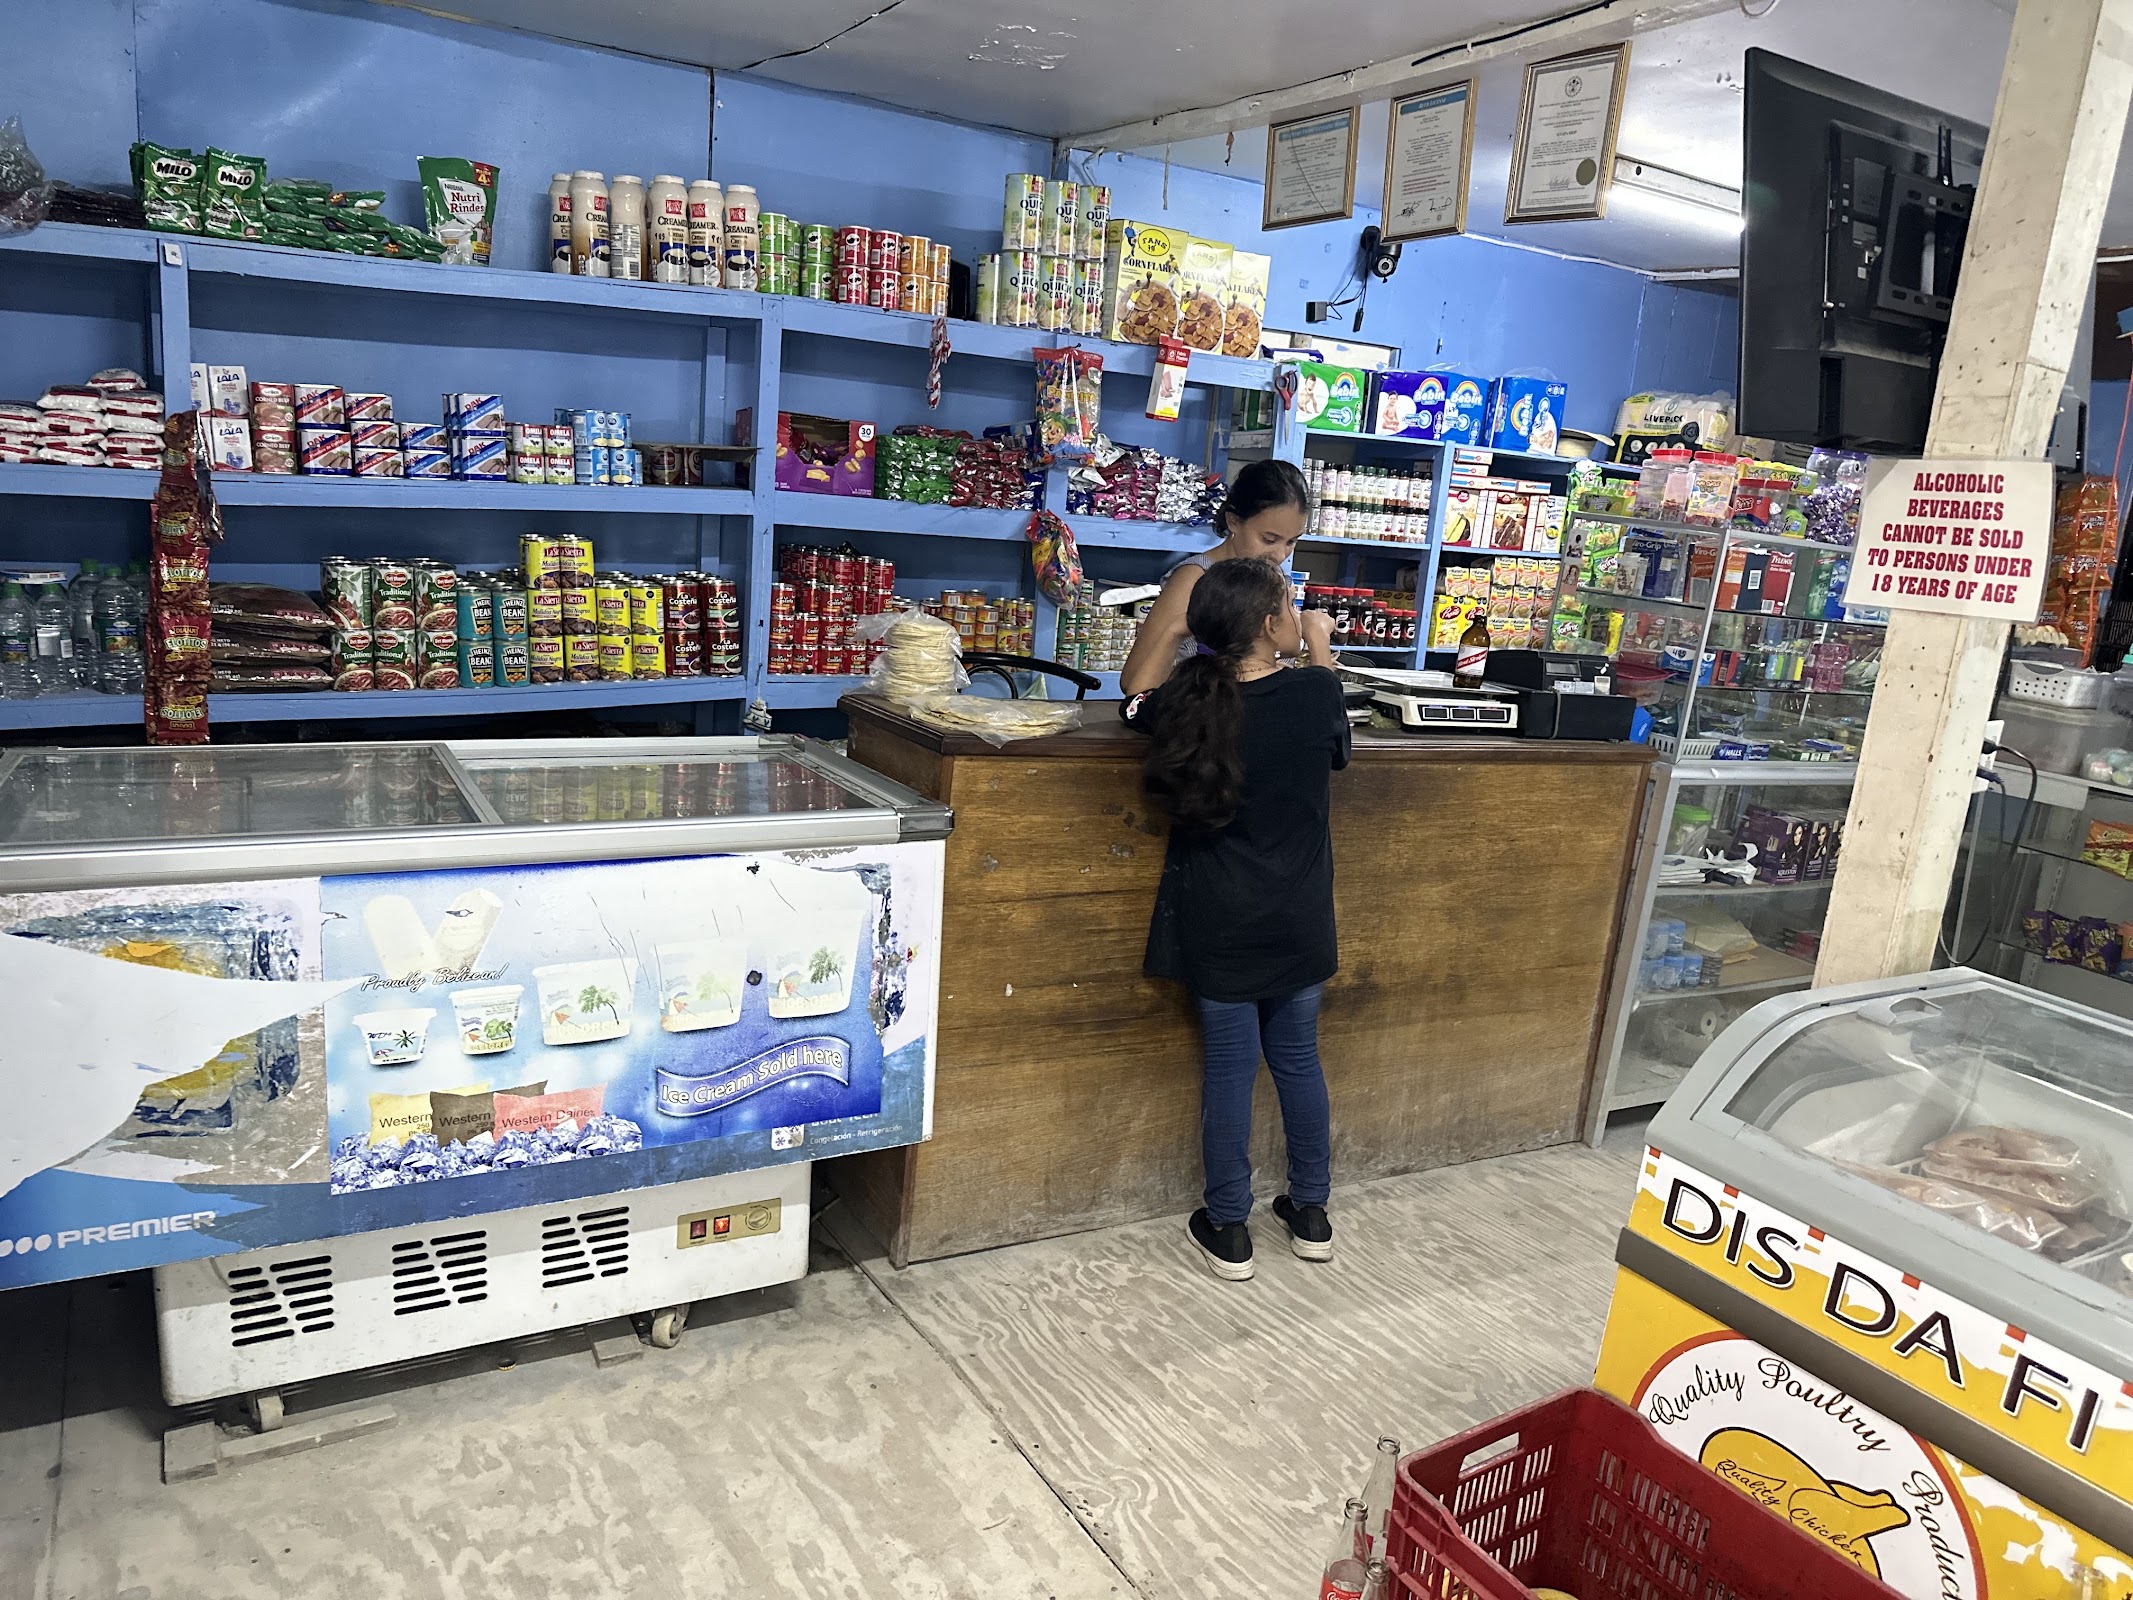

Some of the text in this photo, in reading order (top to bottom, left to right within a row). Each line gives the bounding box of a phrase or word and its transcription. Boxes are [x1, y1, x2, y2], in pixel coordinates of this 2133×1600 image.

[156, 162, 193, 178] MILO
[451, 192, 481, 203] Nutri
[450, 203, 485, 214] Rindes
[217, 373, 240, 383] LALA
[464, 397, 483, 411] DAK
[219, 427, 243, 436] LALA
[550, 428, 570, 437] OMELA
[861, 428, 872, 436] 30
[468, 442, 485, 455] DAK
[519, 457, 540, 465] OMELA
[550, 457, 571, 466] OMELA
[1913, 473, 2005, 494] ALCOHOLIC
[1907, 499, 2004, 521] BEVERAGES
[1882, 523, 2023, 549] CANNOT BE SOLD
[1695, 547, 1717, 555] Viro-G
[1868, 548, 2032, 578] TO PERSONS UNDER
[379, 588, 412, 597] Traditional
[1871, 573, 2018, 604] 18 YEARS OF AGE
[475, 608, 492, 617] BEAN
[503, 608, 526, 617] BEANZ
[165, 637, 208, 650] ELOTITOS
[504, 656, 527, 666] BEANZ
[361, 962, 510, 993] Proudly Belizean!
[661, 1046, 843, 1105] Ice Cream Sold here
[379, 1112, 432, 1128] Western
[439, 1112, 491, 1127] Western
[502, 1109, 596, 1128] Western Dairies
[810, 1133, 852, 1145] Congelación
[57, 1210, 216, 1249] PREMIER
[1662, 1177, 2101, 1455] DIS DA FI
[1649, 1364, 1746, 1425] Quality
[1758, 1357, 1891, 1452] Poultry
[1716, 1459, 1863, 1568] Quality Chicken
